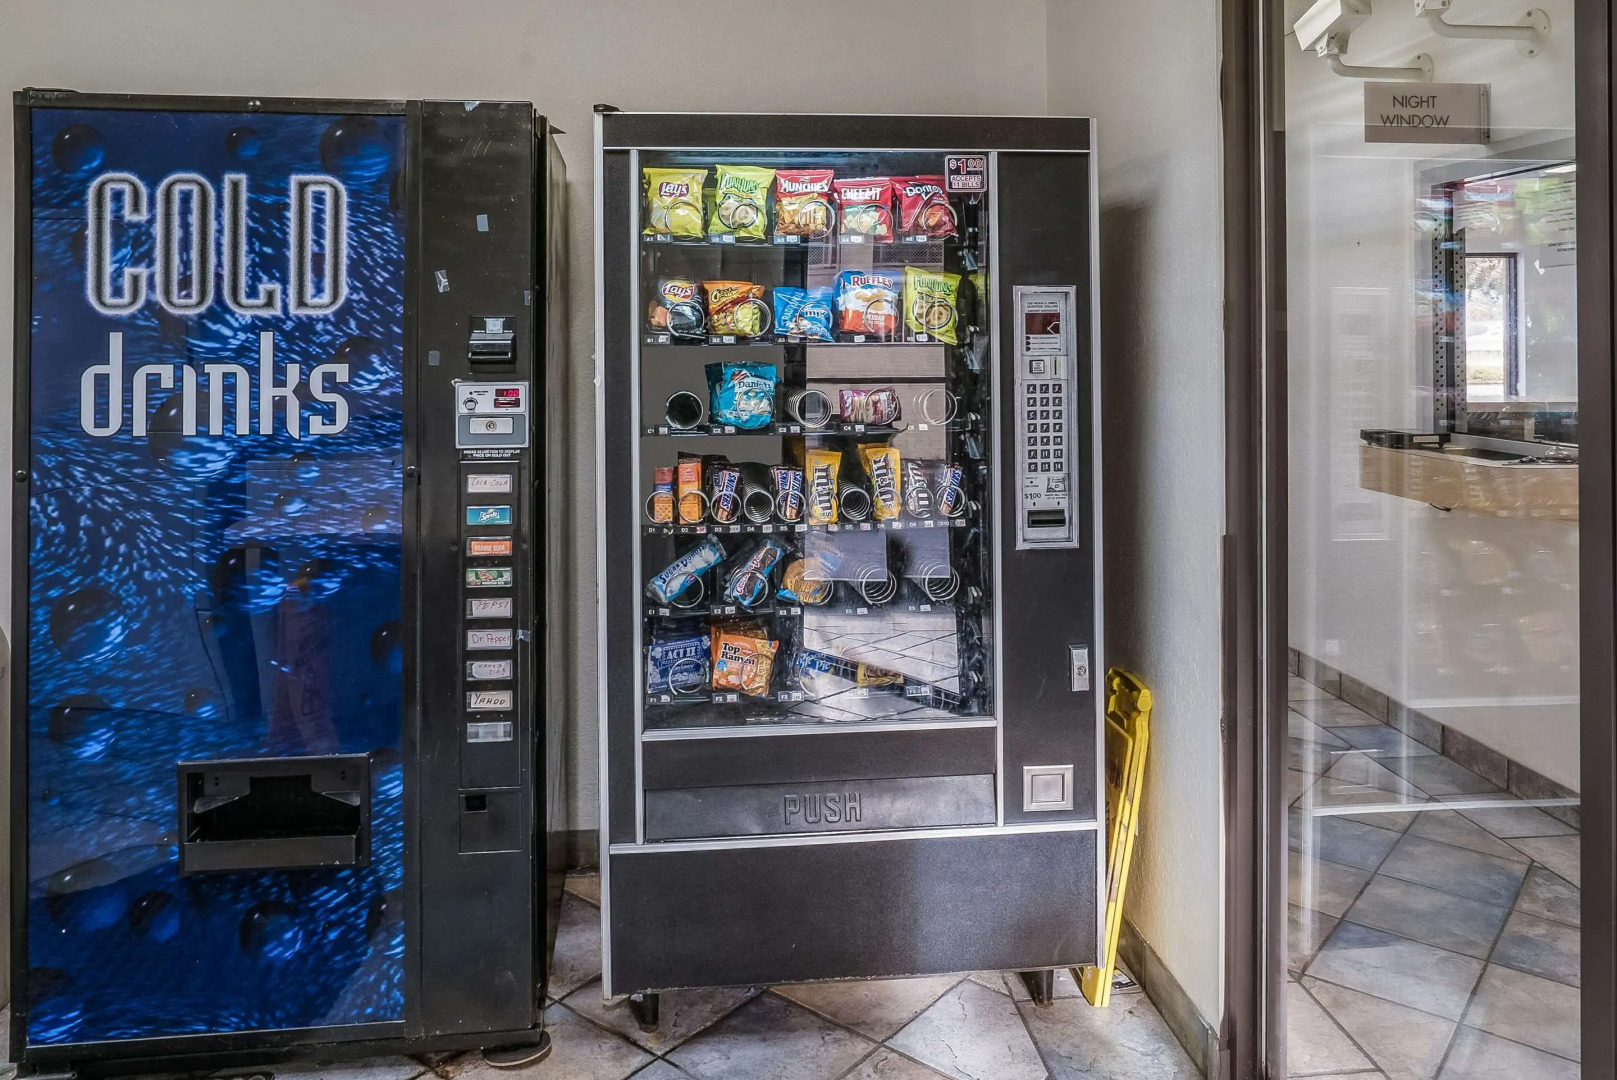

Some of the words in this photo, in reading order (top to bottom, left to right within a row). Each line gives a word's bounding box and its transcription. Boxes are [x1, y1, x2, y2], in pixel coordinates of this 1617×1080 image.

[1392, 95, 1437, 108] NIGHT
[1380, 114, 1450, 128] WINDOW
[780, 179, 829, 193] MUNCHIES
[86, 171, 350, 316] COLD
[851, 276, 893, 290] RUFFLES
[80, 330, 350, 440] drinks
[738, 380, 772, 389] Danish
[476, 601, 509, 610] PEPSI
[472, 634, 483, 644] Dr
[487, 633, 511, 644] Pepper
[667, 648, 684, 660] ACT
[686, 647, 696, 656] II
[722, 642, 740, 655] Top
[720, 650, 755, 666] Ramen
[474, 694, 506, 705] YAHOO
[784, 792, 862, 826] PUSH
